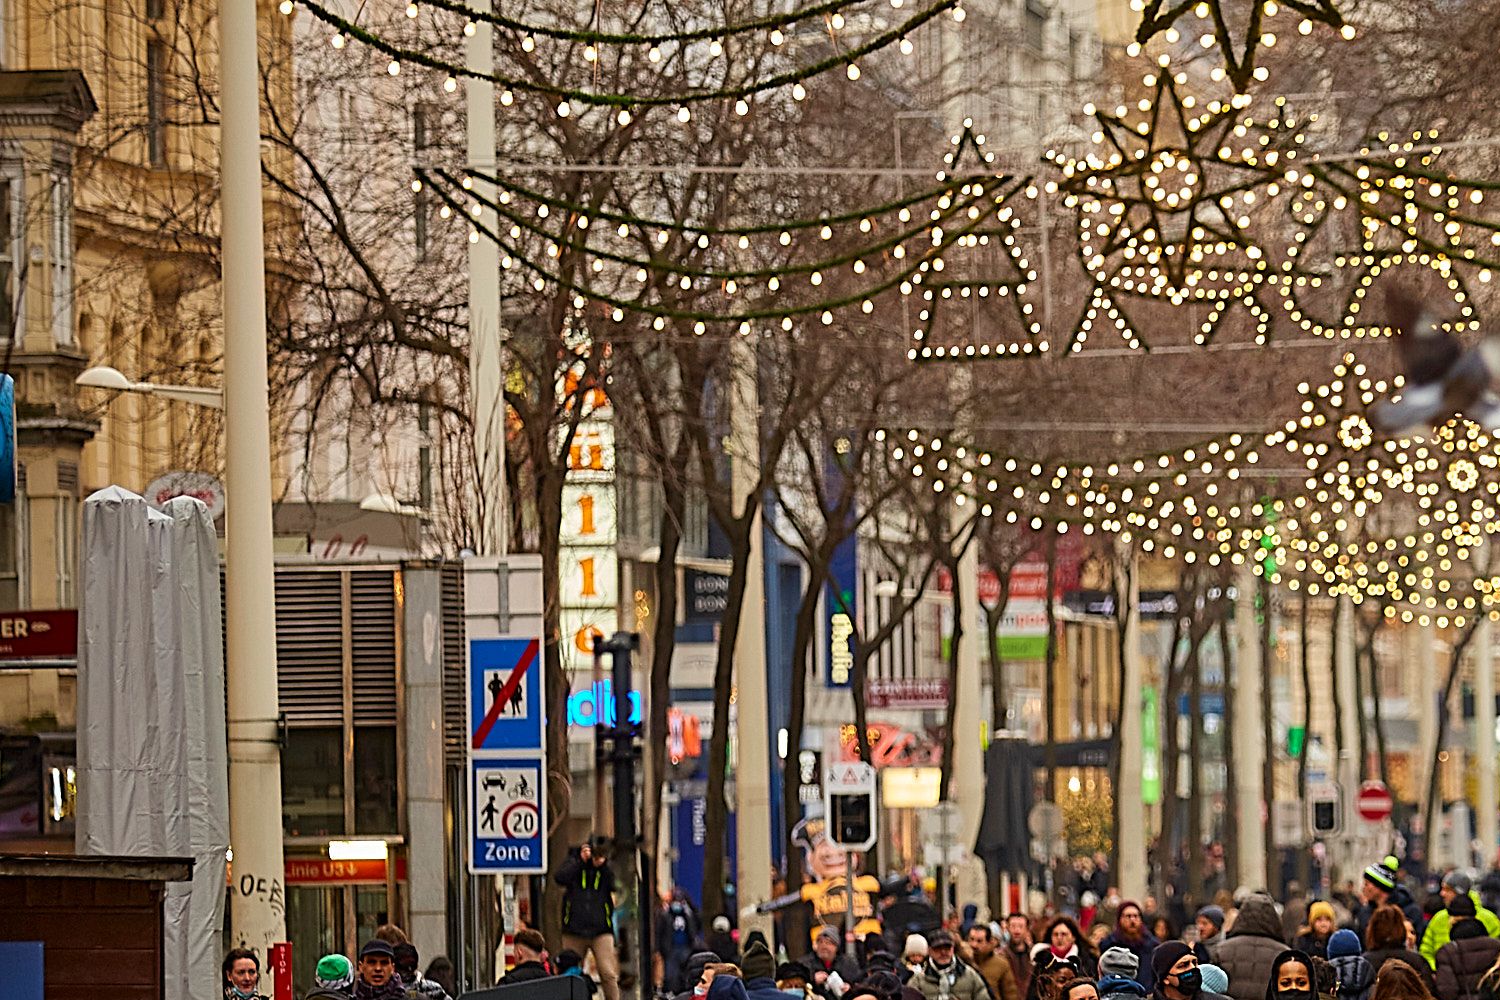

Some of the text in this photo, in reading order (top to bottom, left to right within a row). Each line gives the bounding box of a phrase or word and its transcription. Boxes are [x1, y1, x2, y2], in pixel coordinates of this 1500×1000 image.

[512, 812, 534, 834] 20
[485, 841, 531, 862] Zone
[322, 861, 346, 877] U3
[279, 946, 287, 974] STOP
